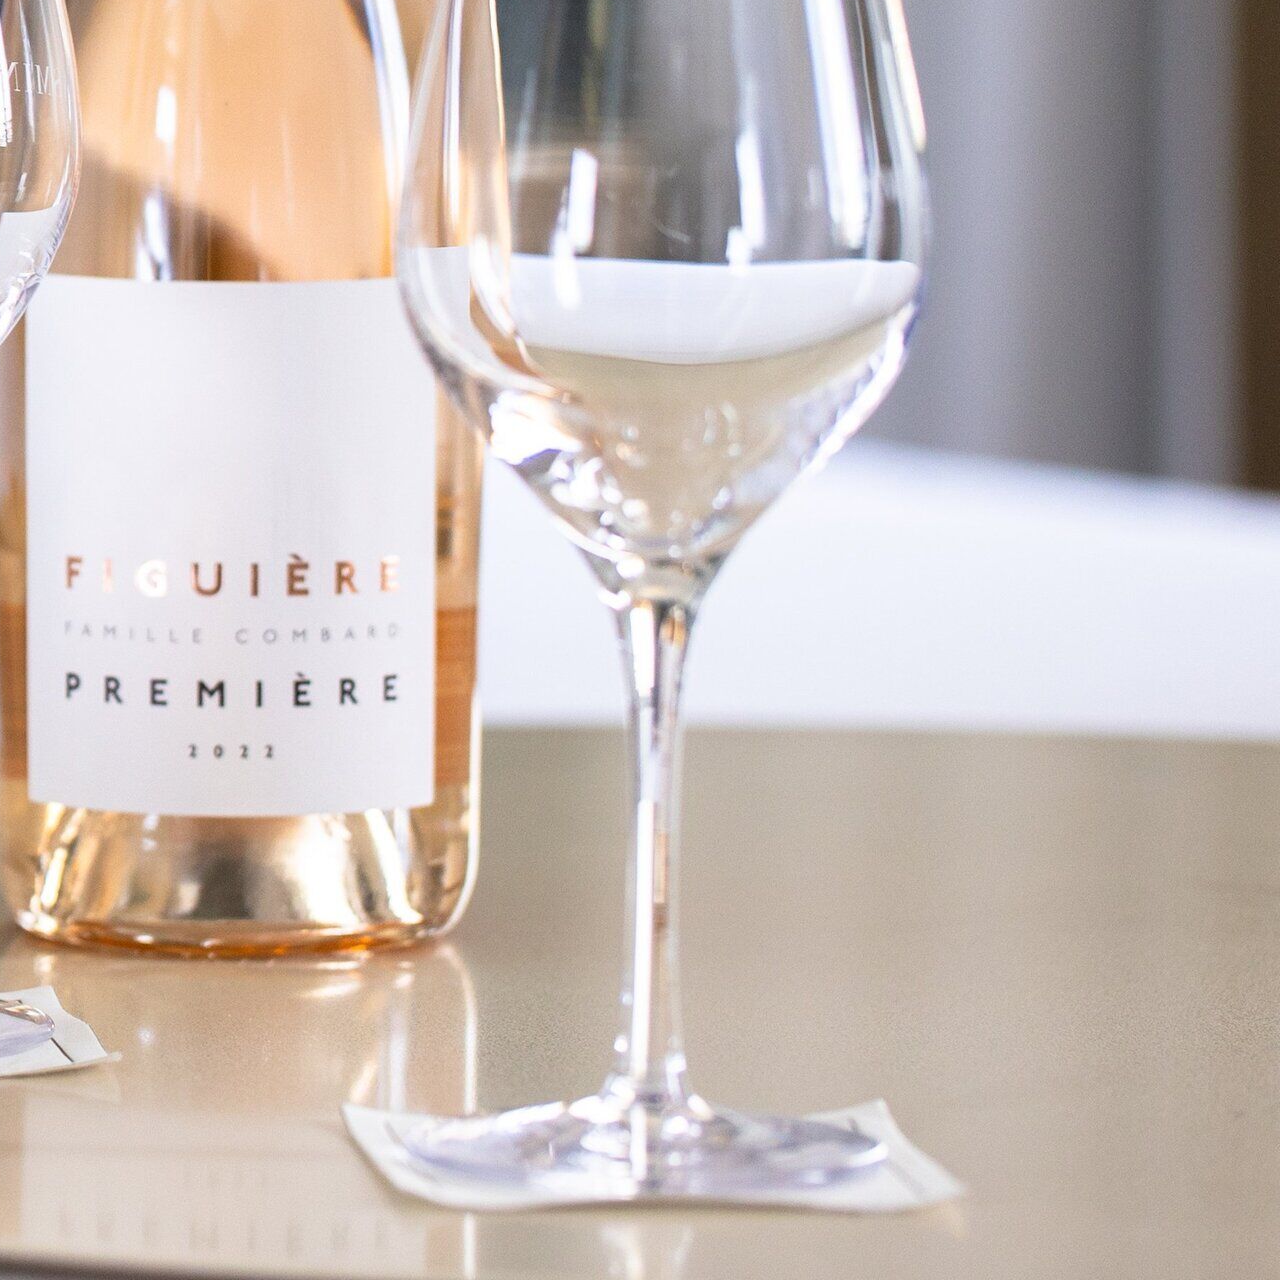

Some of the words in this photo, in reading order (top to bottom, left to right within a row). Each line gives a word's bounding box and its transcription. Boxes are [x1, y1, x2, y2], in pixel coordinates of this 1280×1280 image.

[64, 553, 401, 597] FIGUIÈRE
[63, 620, 203, 644] FAMILLE
[234, 622, 401, 645] COMBARD
[64, 671, 399, 708] PREMIÈRE
[187, 743, 276, 760] 2022
